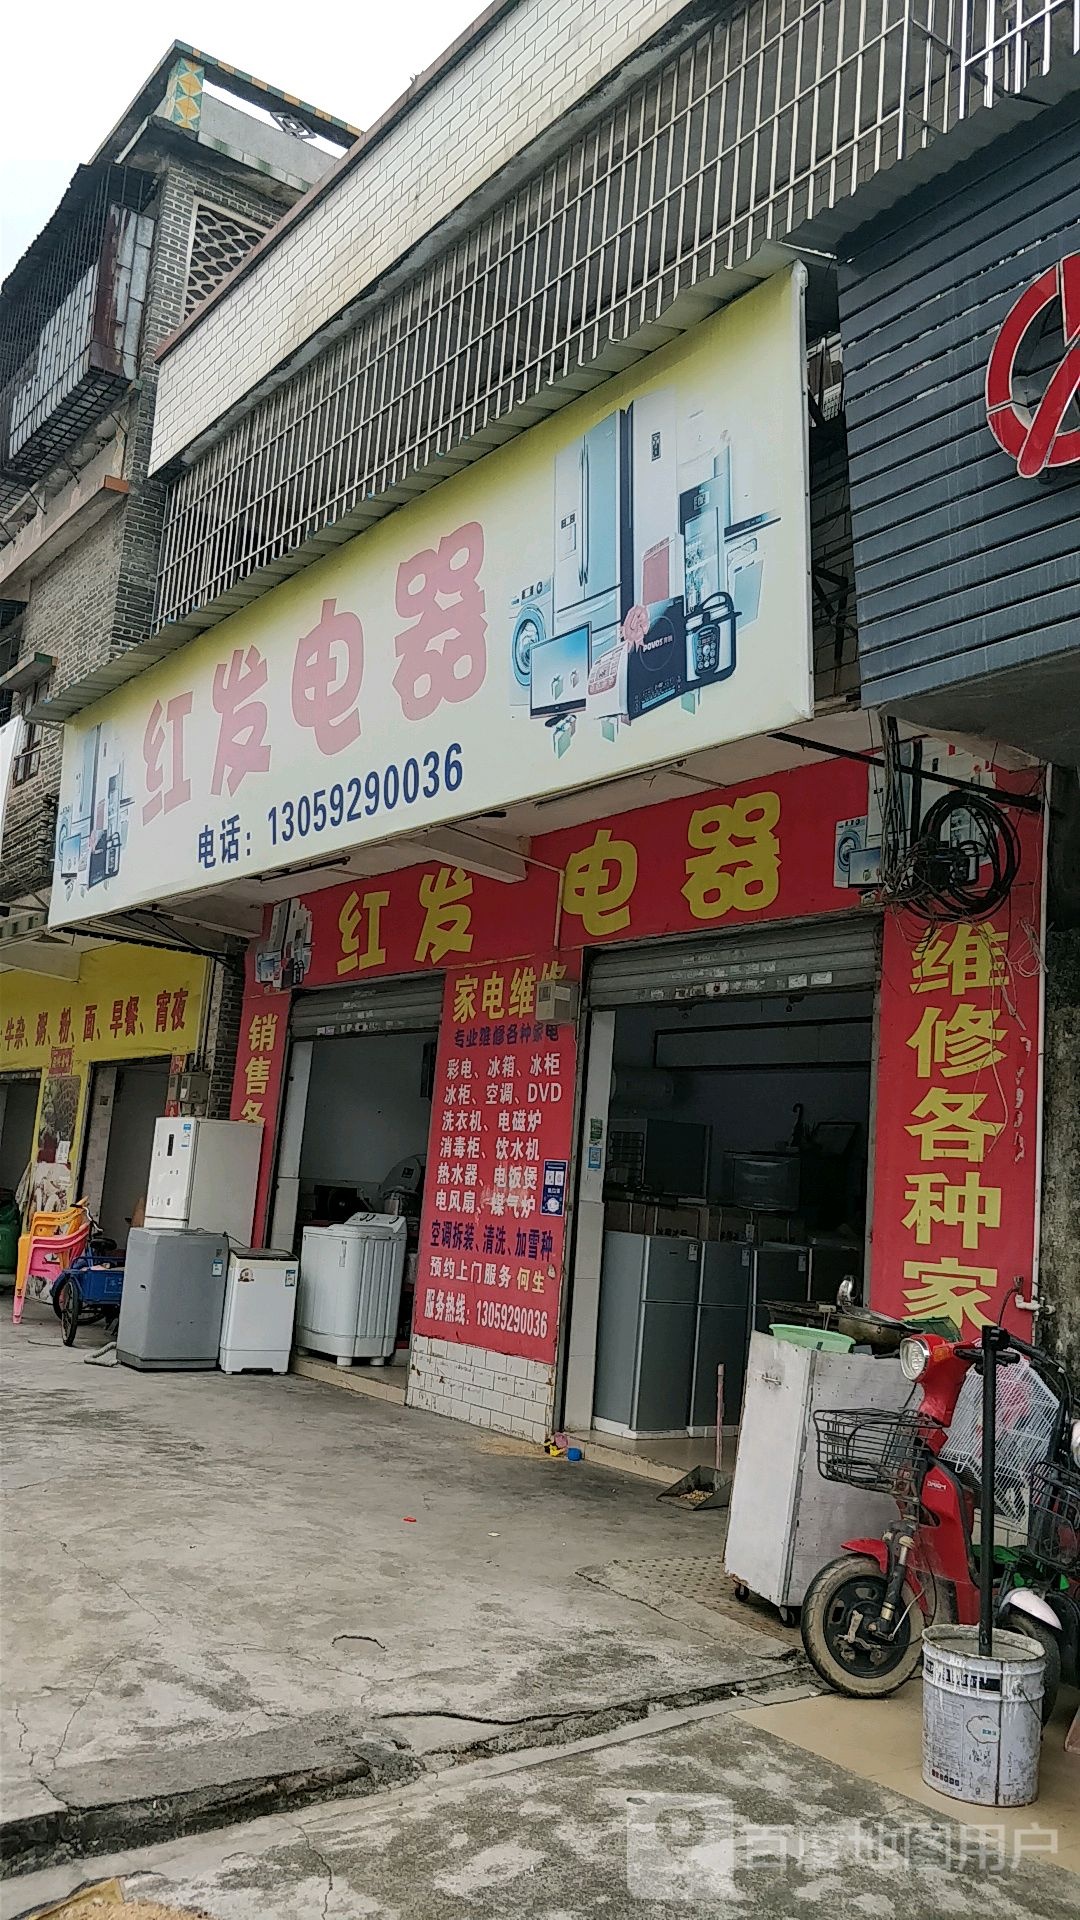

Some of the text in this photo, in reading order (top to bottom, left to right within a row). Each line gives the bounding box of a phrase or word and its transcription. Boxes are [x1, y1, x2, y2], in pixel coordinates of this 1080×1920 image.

[142, 521, 488, 827] 红发电器
[336, 790, 782, 975] 红发电器
[453, 1021, 560, 1049] 专业维修各种家电
[446, 1051, 561, 1081] 彩电、冰箱、冰柜
[443, 1082, 563, 1106] 冰柜、空调、DVD
[441, 1108, 543, 1133] 洗衣机、电磁炉
[902, 922, 1010, 1330] 维修各种家
[439, 1135, 540, 1162] 消毒柜、饮水机
[436, 1162, 539, 1192] 热水器、电饭煲
[429, 1218, 554, 1263] 空调拆装、清洗、加雪种
[429, 1254, 546, 1295] 预约上门服务 何生
